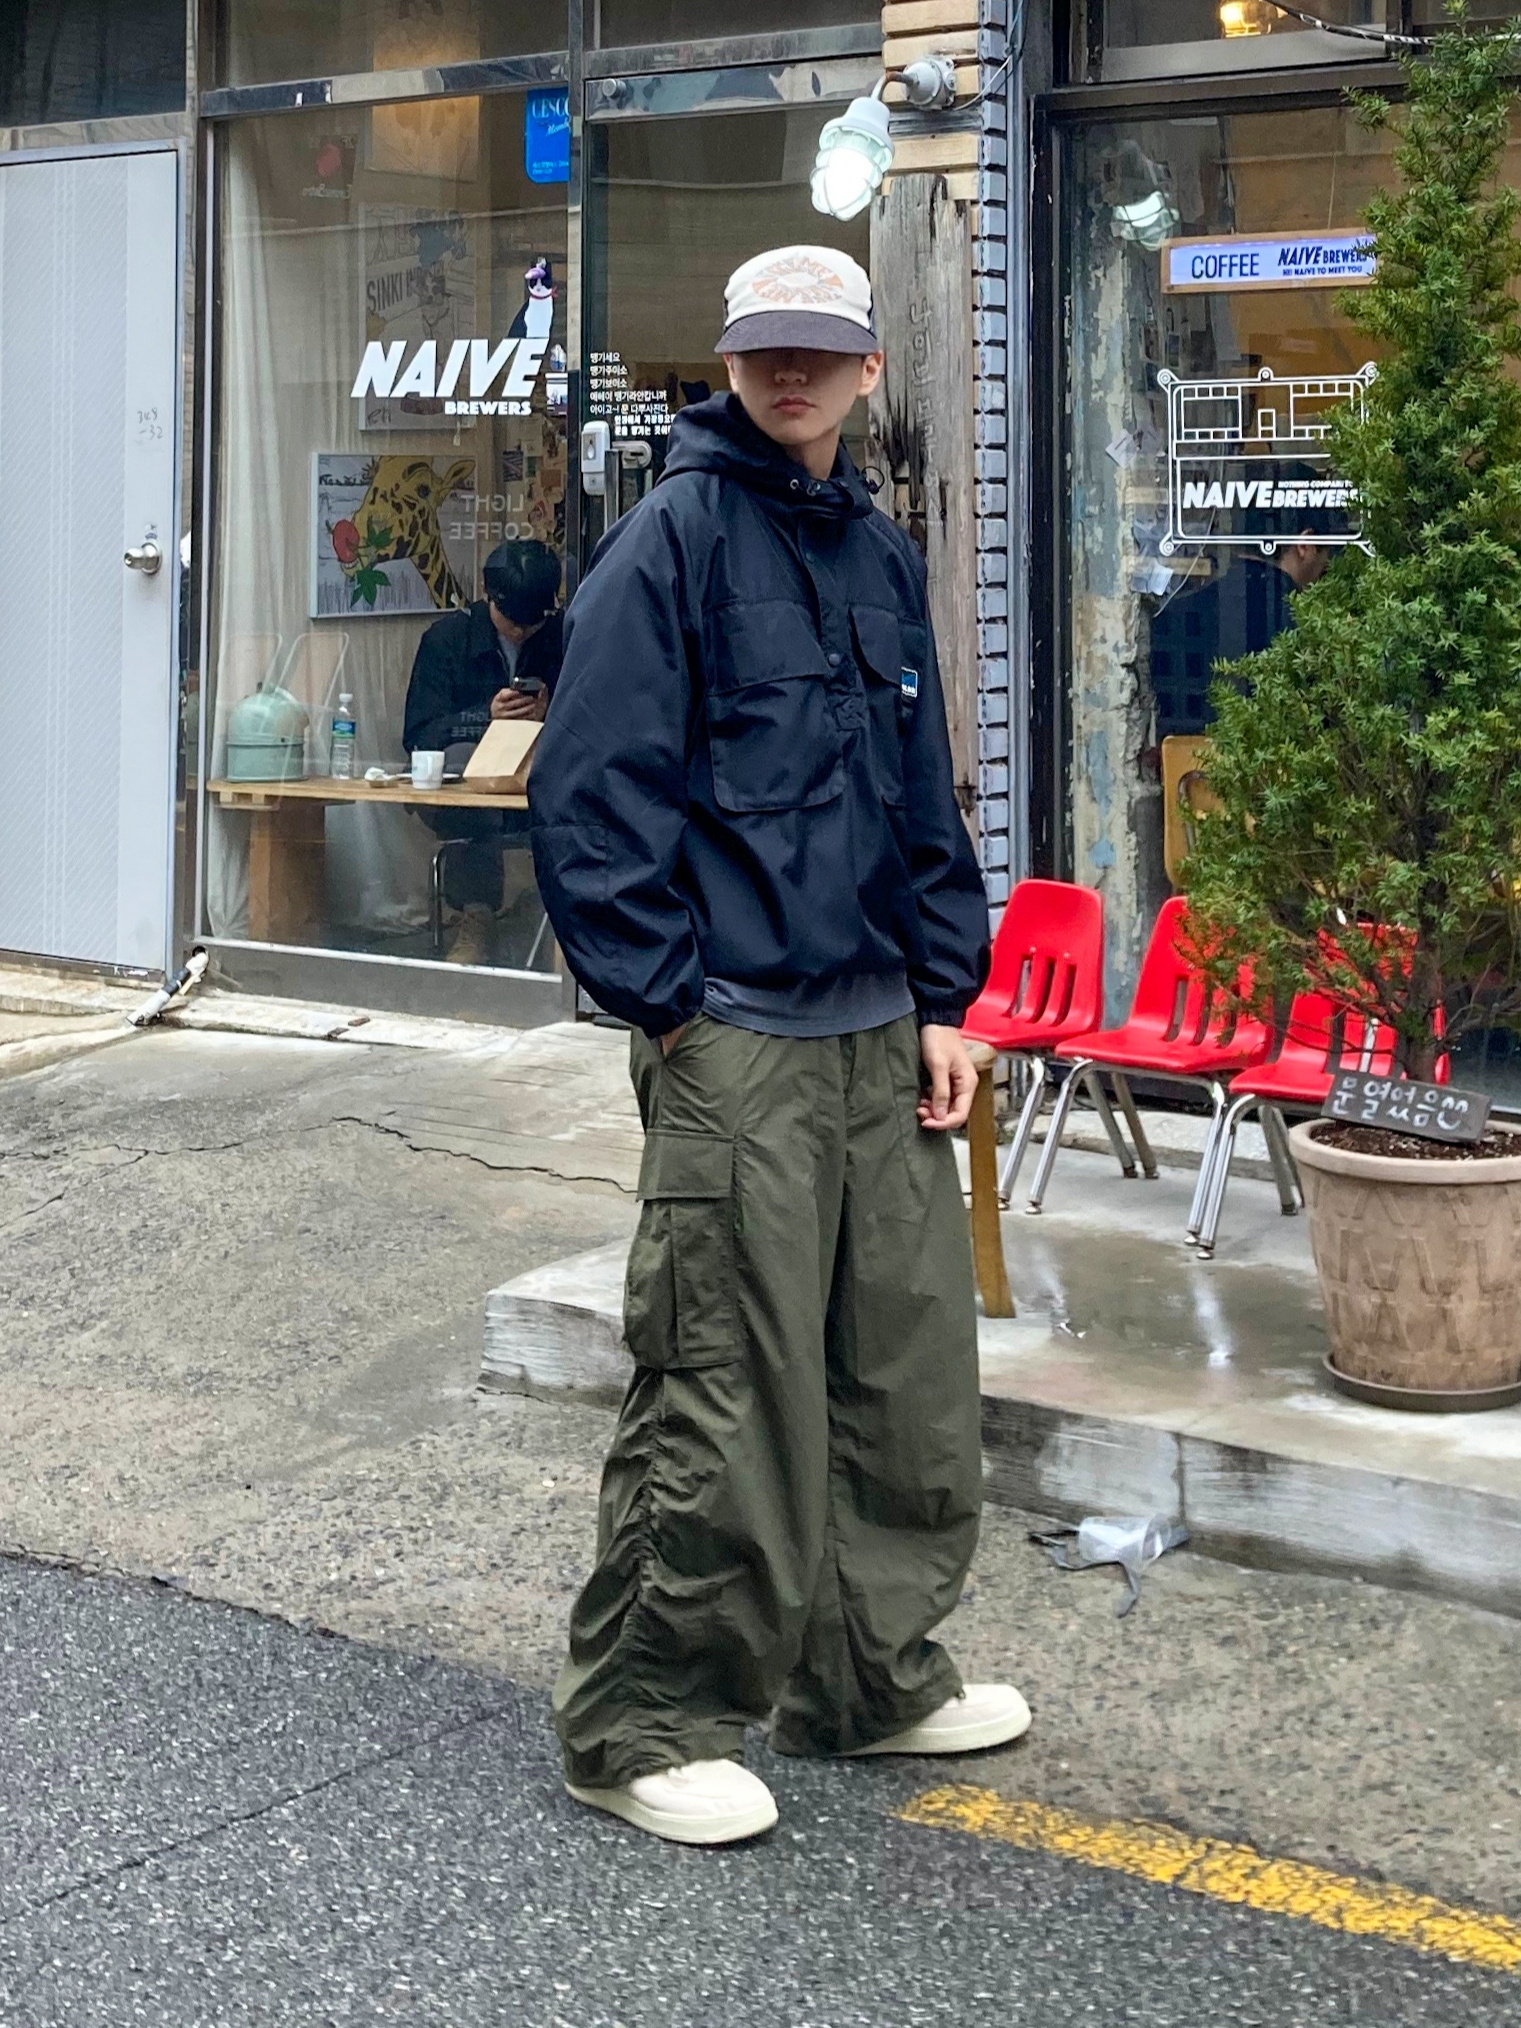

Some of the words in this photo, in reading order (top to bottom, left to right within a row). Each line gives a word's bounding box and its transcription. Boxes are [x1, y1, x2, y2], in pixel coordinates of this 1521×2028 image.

[1191, 253, 1260, 279] COFFEE
[1277, 246, 1323, 267] NAIVE
[1317, 267, 1327, 275] TO
[1328, 266, 1346, 275] MEET
[1347, 265, 1364, 274] YOU
[350, 338, 550, 398] NAIVE
[444, 401, 532, 416] BREWERS
[1182, 481, 1274, 509] NAIVE
